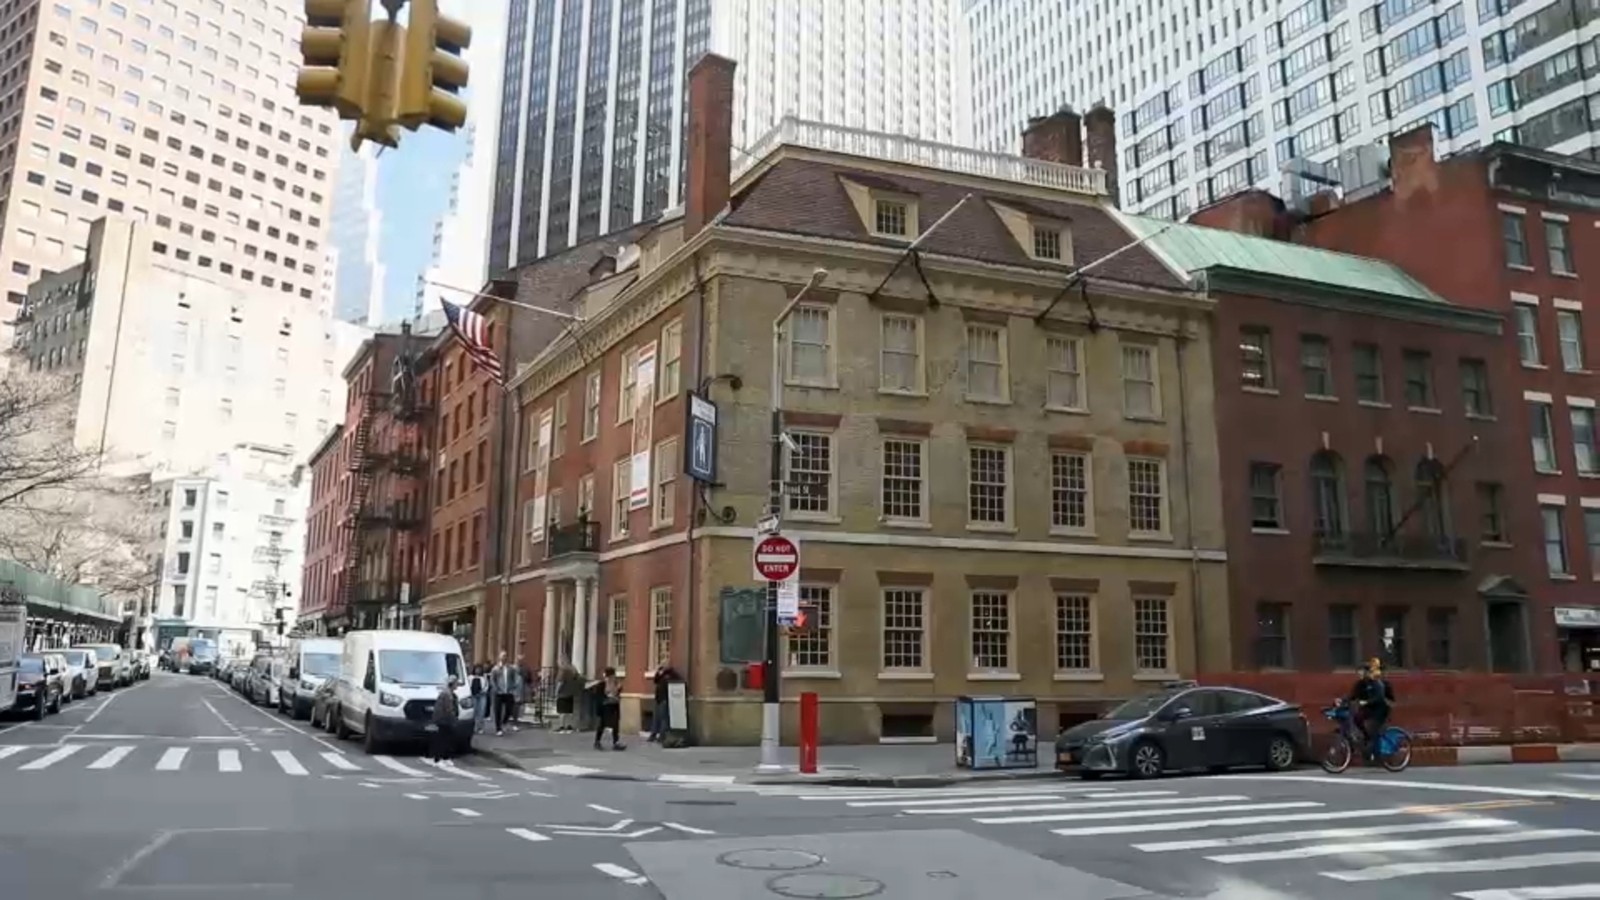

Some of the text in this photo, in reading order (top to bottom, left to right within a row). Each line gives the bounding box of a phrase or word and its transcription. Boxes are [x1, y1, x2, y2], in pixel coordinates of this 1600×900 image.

[762, 544, 791, 553] DO NOT
[763, 564, 789, 573] ENTER
